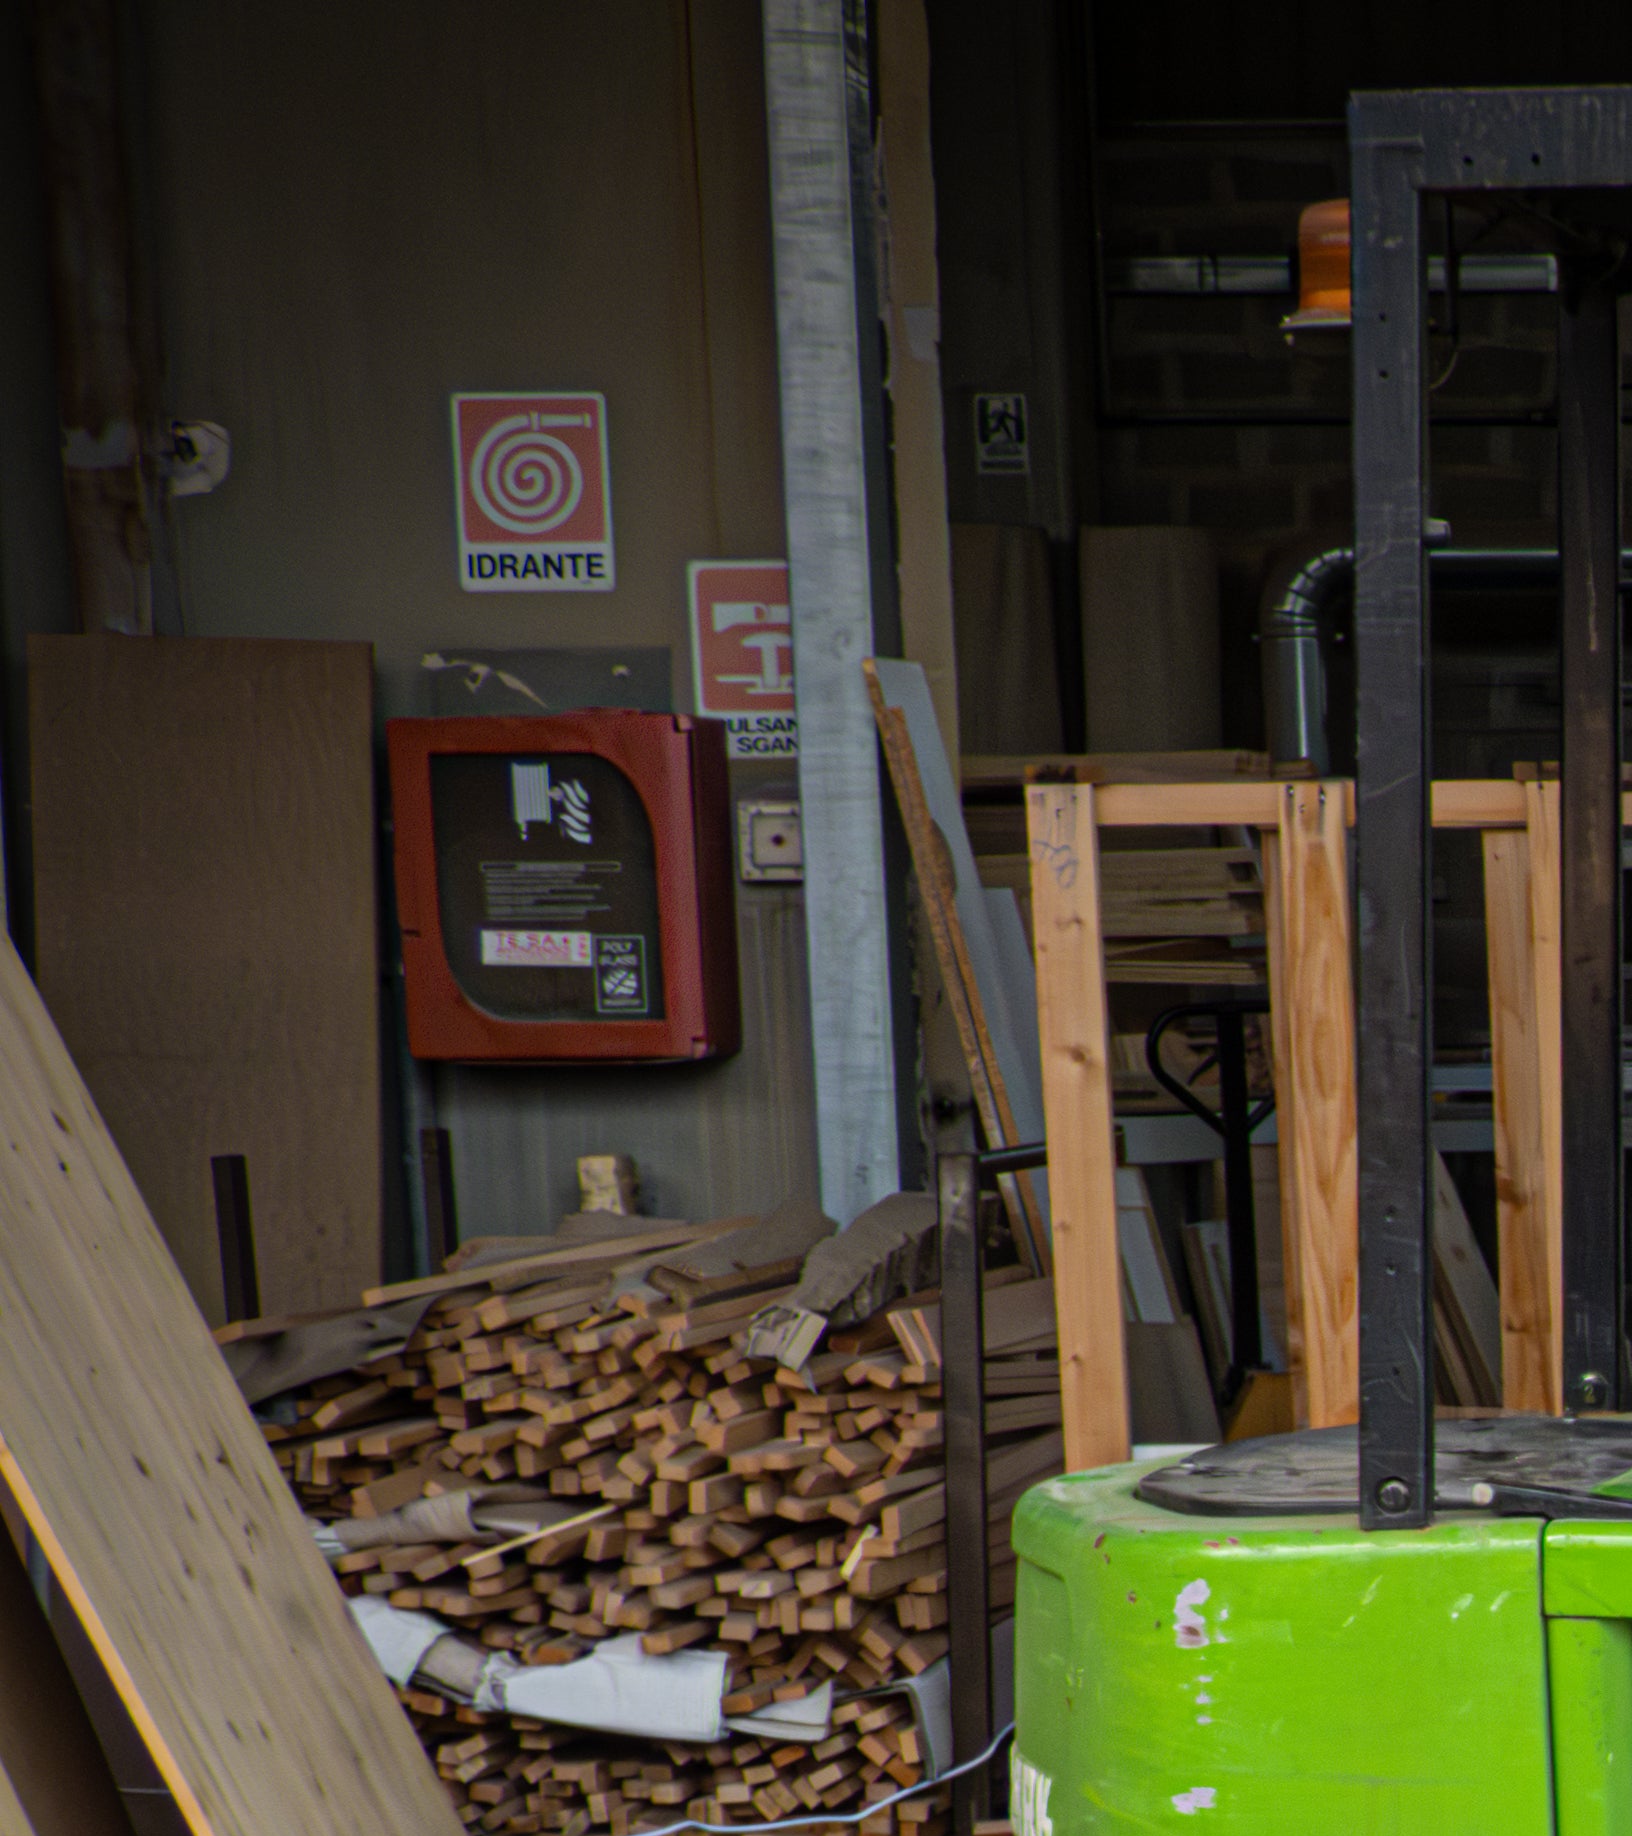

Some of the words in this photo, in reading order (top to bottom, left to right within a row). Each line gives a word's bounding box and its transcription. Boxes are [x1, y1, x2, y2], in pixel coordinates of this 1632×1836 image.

[467, 552, 604, 579] IDRANTE
[726, 716, 798, 733] ULSAN
[736, 736, 798, 752] SGAN
